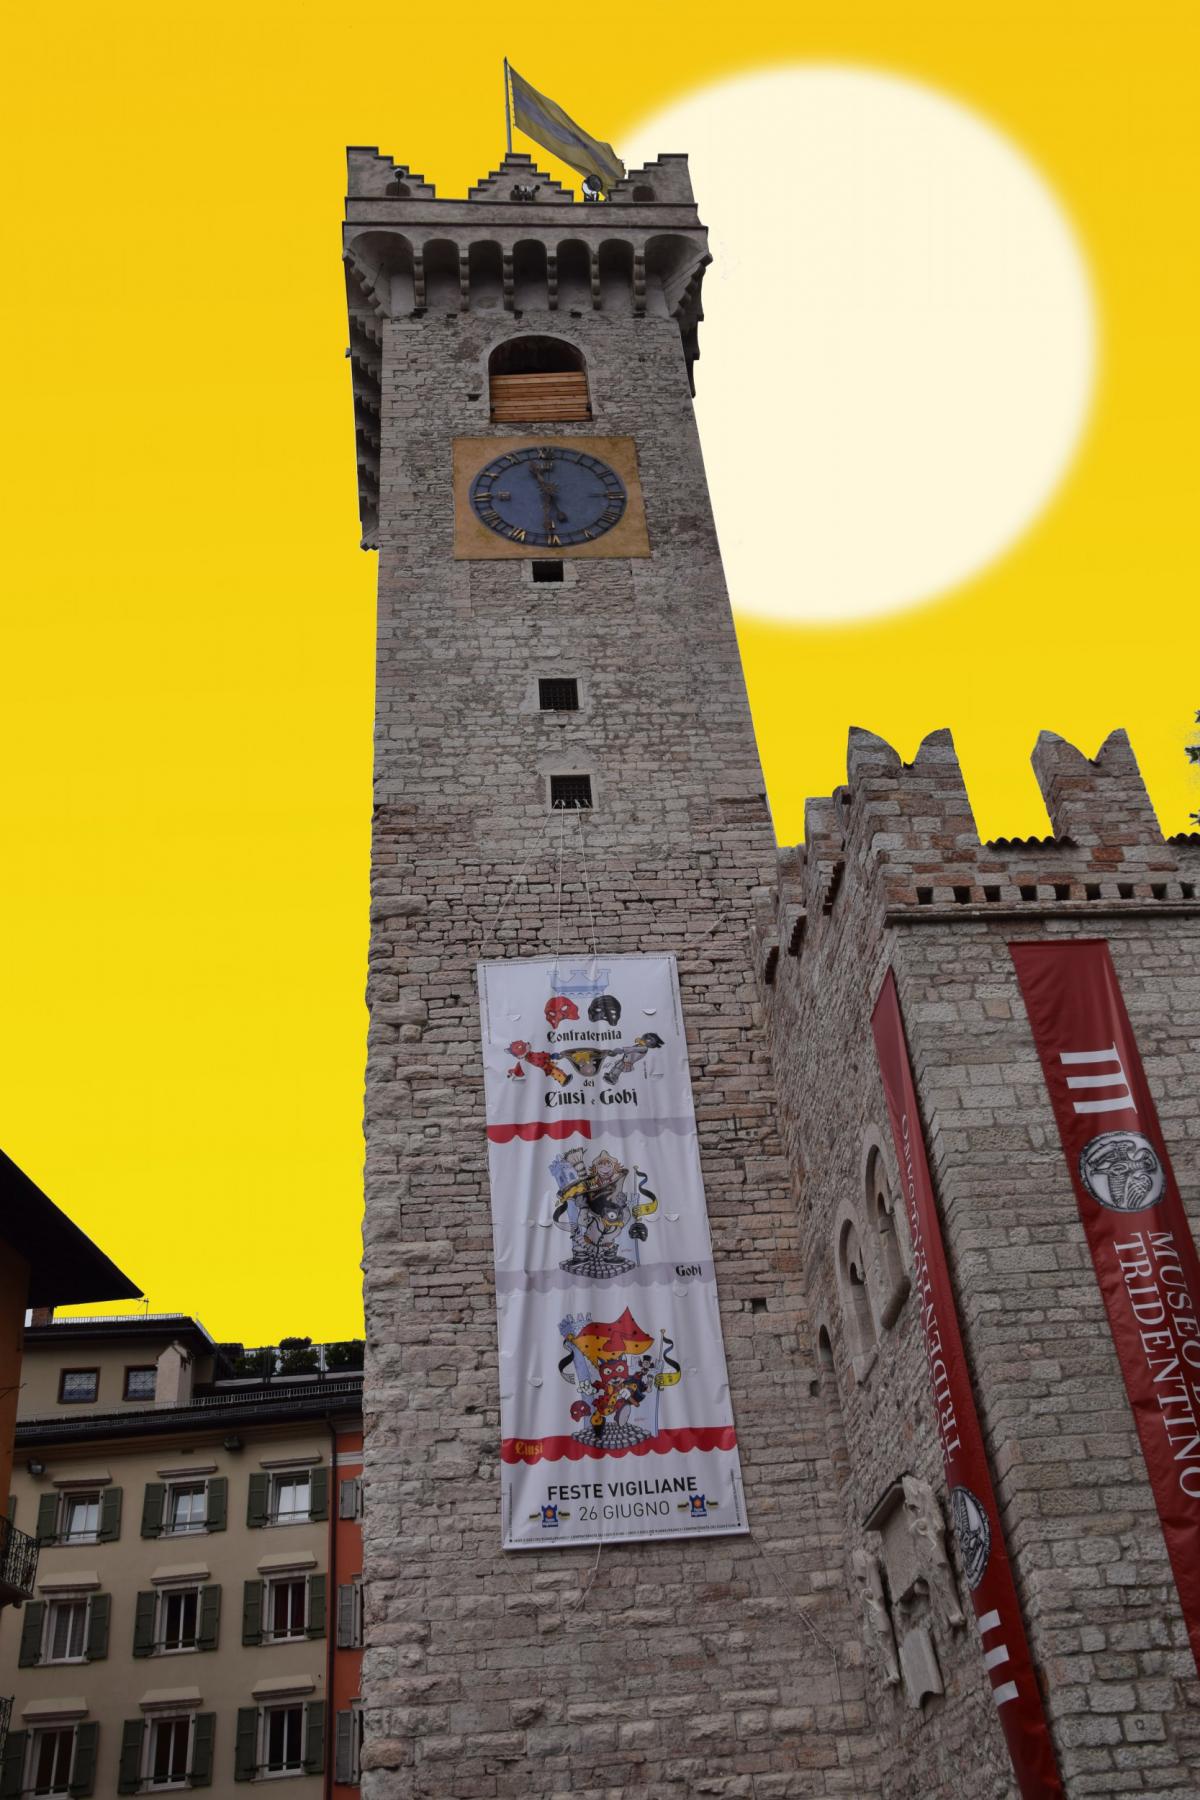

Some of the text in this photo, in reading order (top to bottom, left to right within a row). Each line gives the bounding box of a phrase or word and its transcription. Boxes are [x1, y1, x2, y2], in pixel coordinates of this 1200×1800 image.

[547, 1029, 622, 1043] Confraternita
[583, 1079, 595, 1087] dei
[544, 1089, 585, 1107] Ciusi
[600, 1088, 638, 1107] Gobi
[675, 1264, 702, 1277] Gobi
[1113, 1231, 1200, 1498] TRIDENTINO
[547, 1476, 698, 1500] FESTE VIGILIANE
[579, 1500, 670, 1521] 26 GIUGNO
